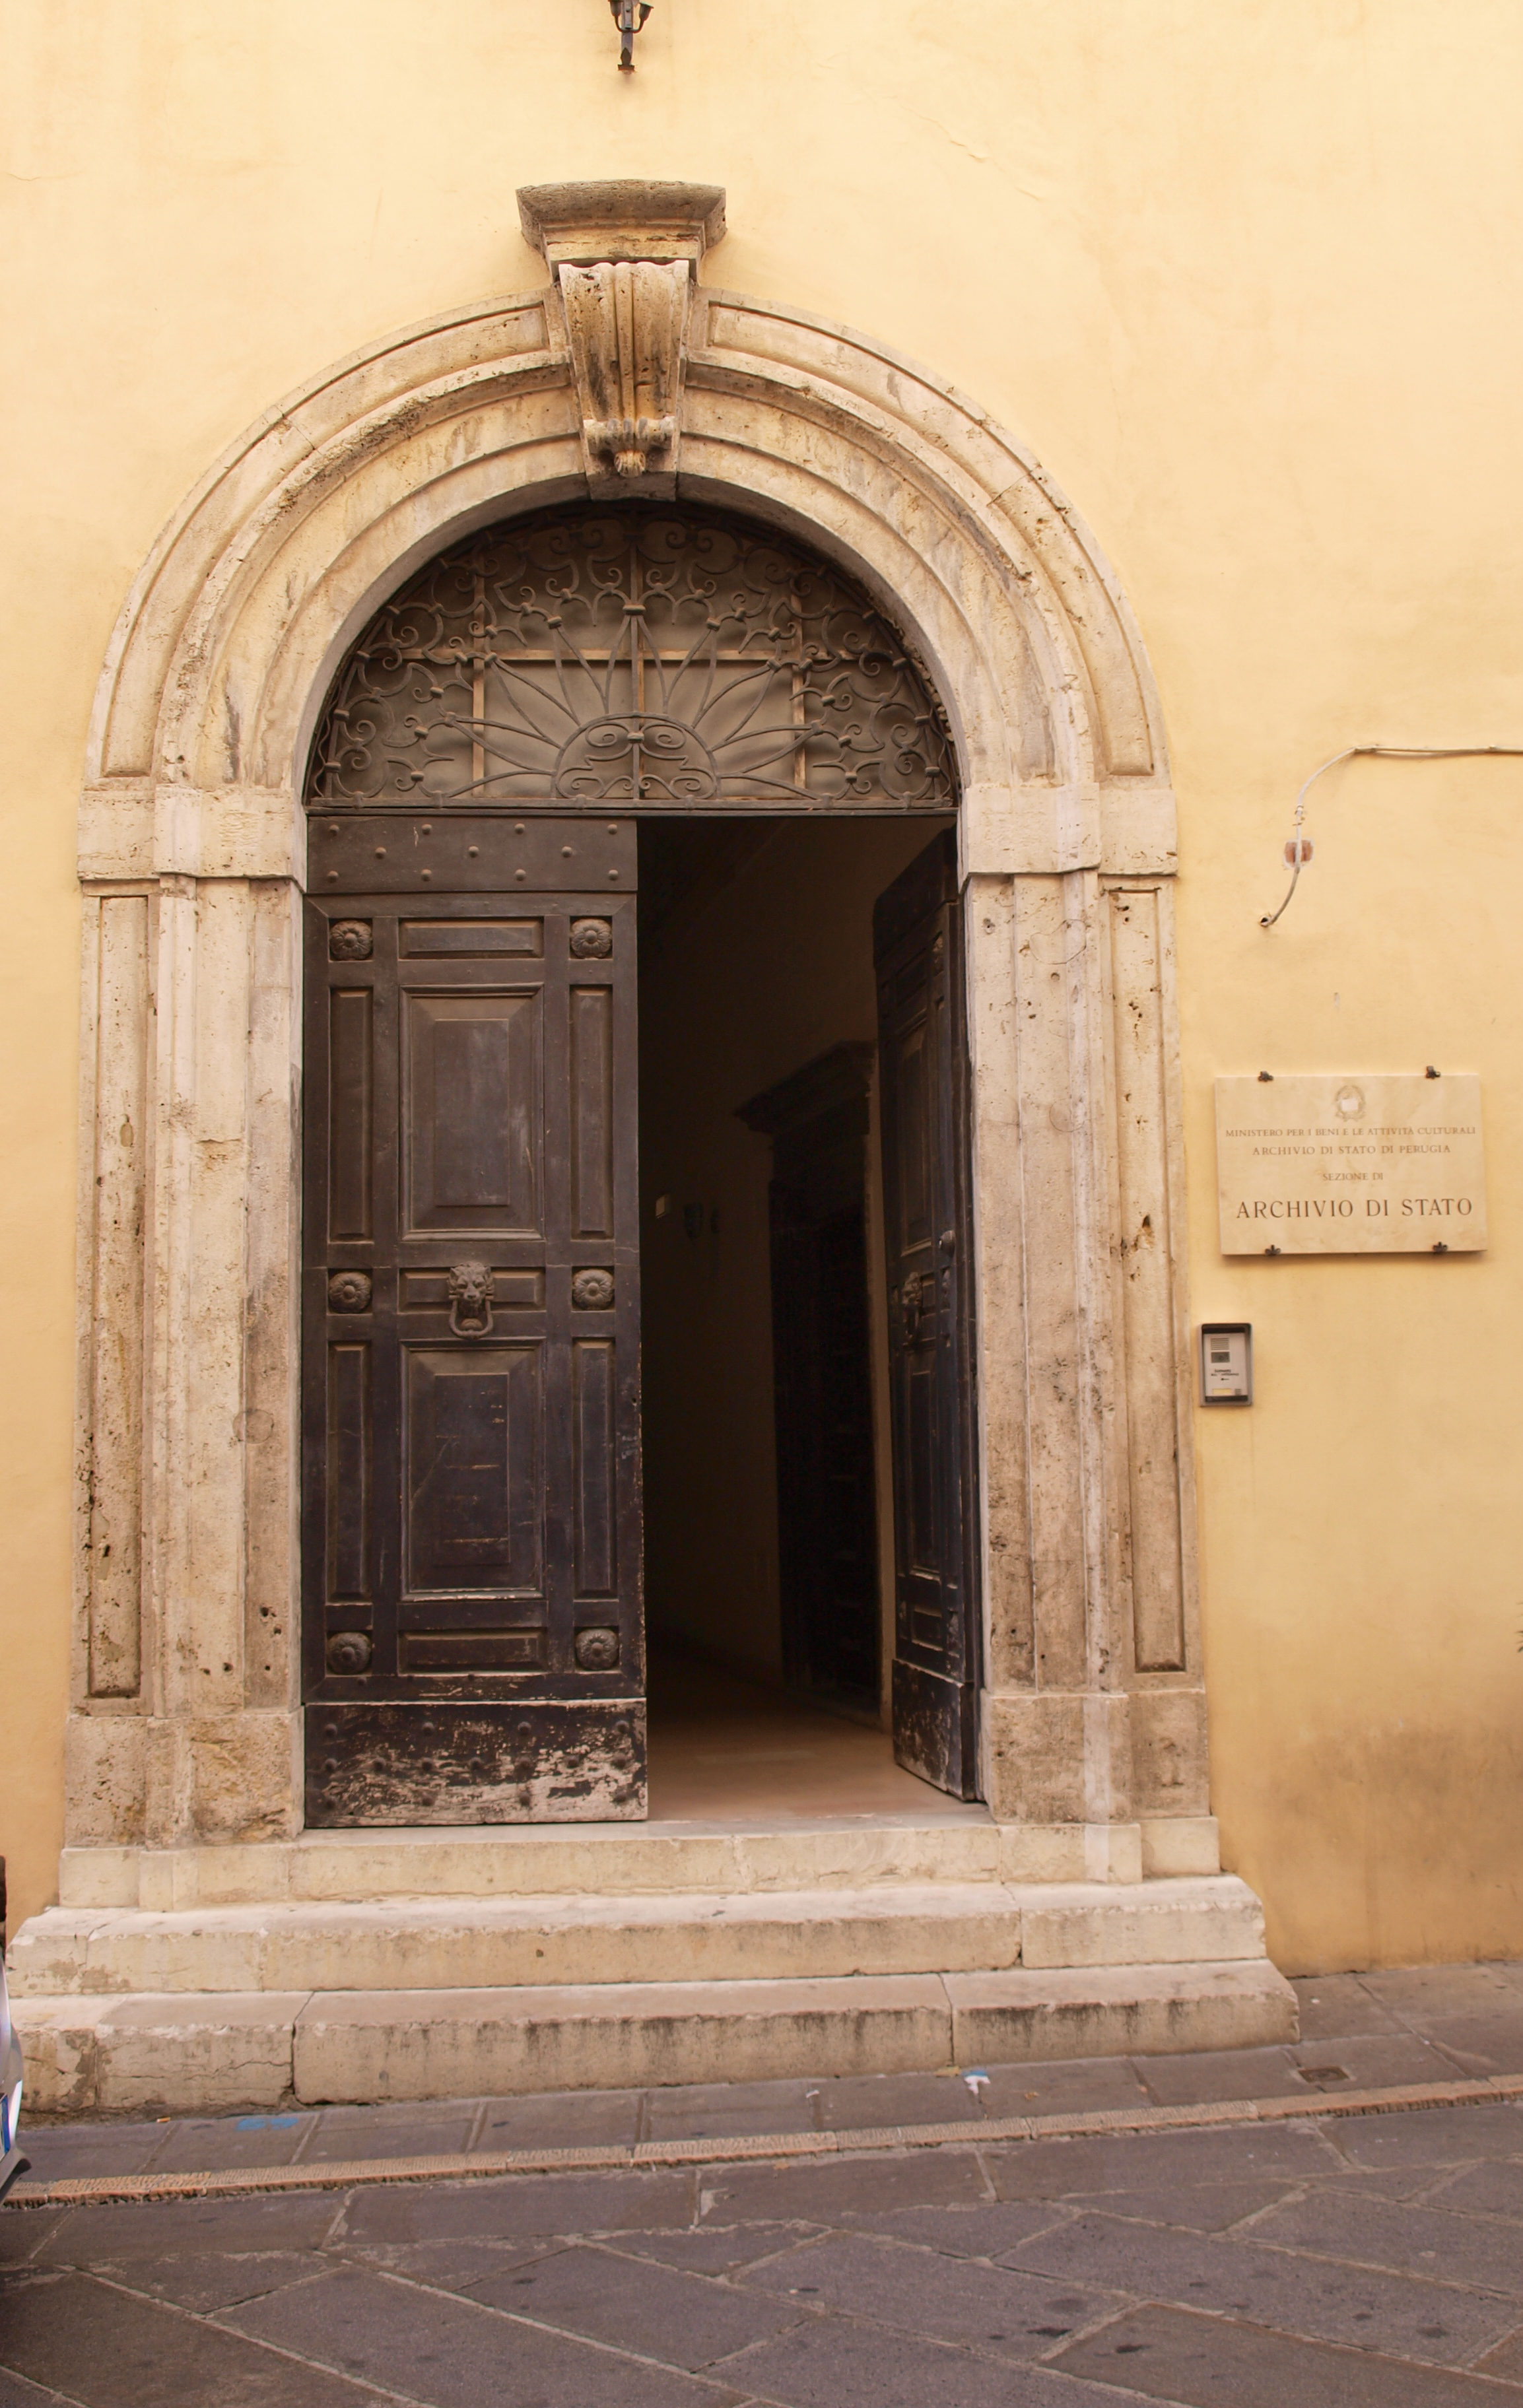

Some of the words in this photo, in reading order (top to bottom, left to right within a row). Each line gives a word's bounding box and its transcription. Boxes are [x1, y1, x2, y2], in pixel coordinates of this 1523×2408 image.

[1253, 1146, 1315, 1155] ARCHIVIO
[1339, 1145, 1376, 1154] STATO
[1382, 1145, 1394, 1154] DI
[1400, 1145, 1450, 1153] PERUGIA
[1323, 1172, 1369, 1181] SEZIONE
[1236, 1199, 1353, 1219] ARCHIVIO
[1367, 1199, 1389, 1217] DI
[1402, 1198, 1472, 1216] STATO
